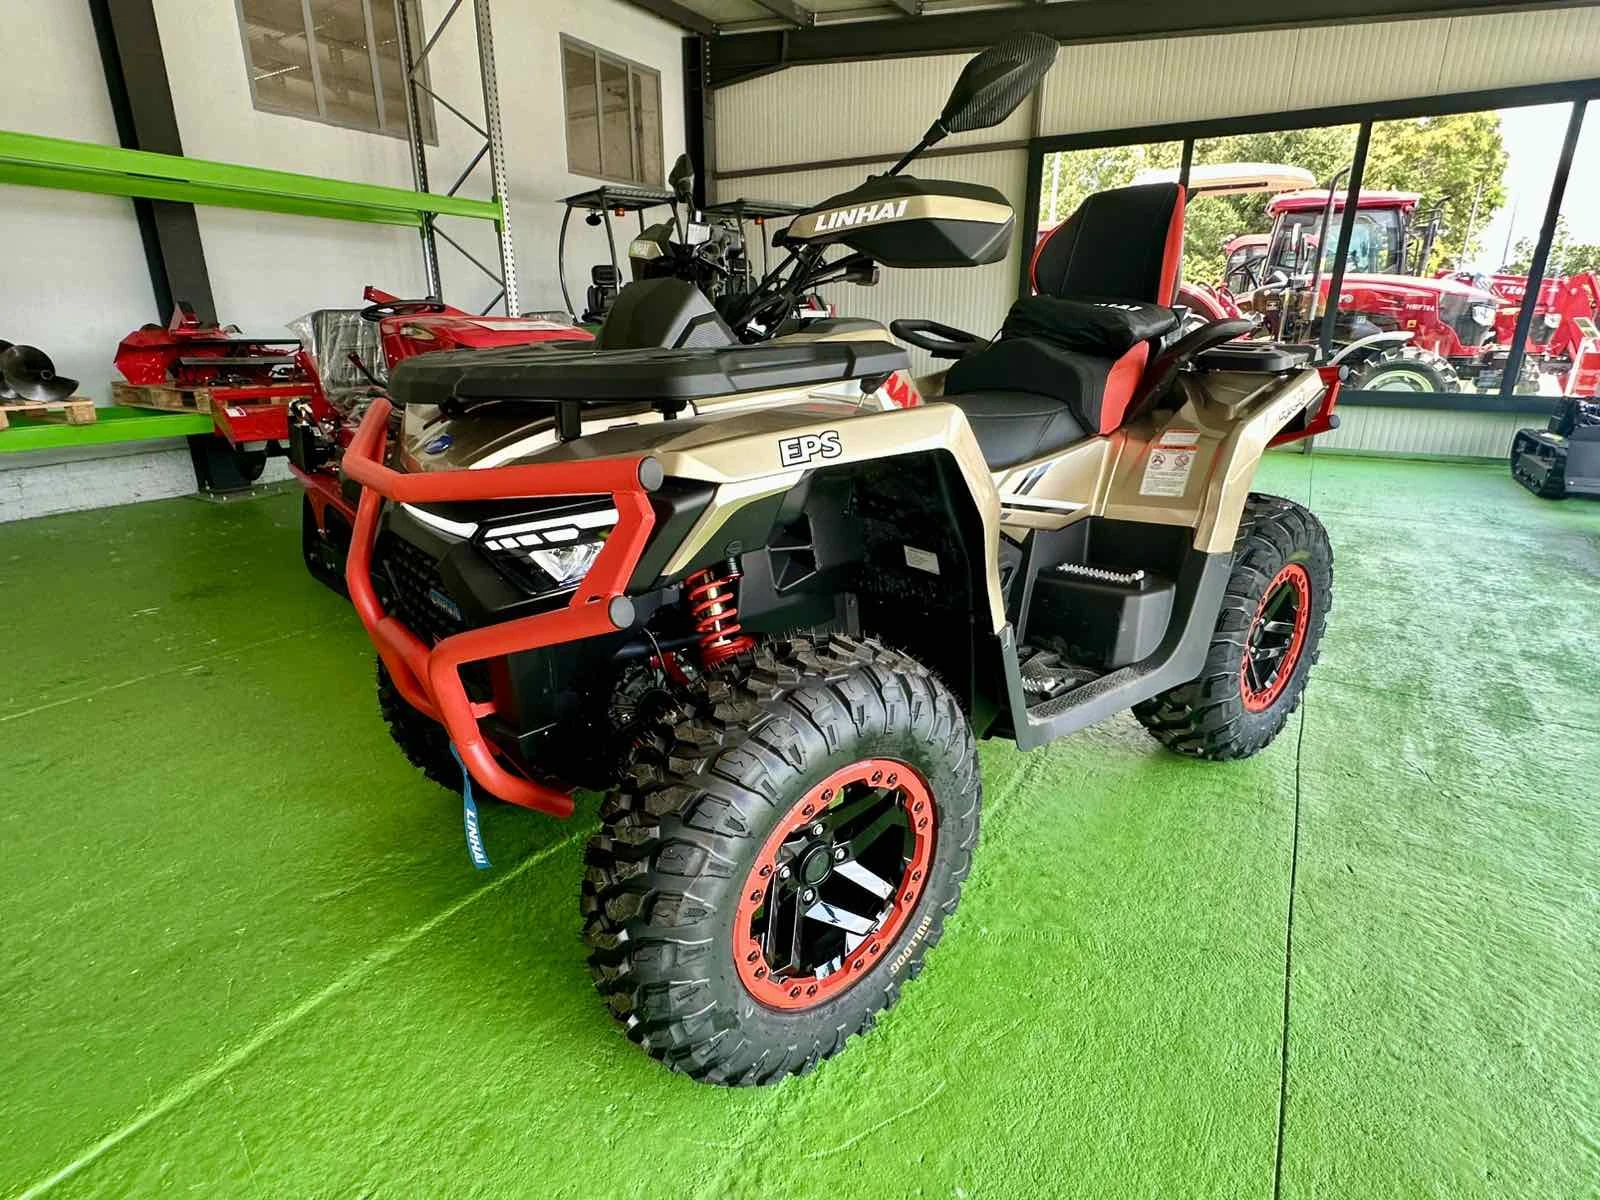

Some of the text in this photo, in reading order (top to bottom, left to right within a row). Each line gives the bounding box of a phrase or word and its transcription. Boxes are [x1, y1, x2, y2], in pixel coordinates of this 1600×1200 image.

[814, 199, 908, 232] LINHAI
[778, 429, 843, 468] EPS
[466, 808, 487, 864] LINHAI
[890, 915, 932, 974] BULLDOG
